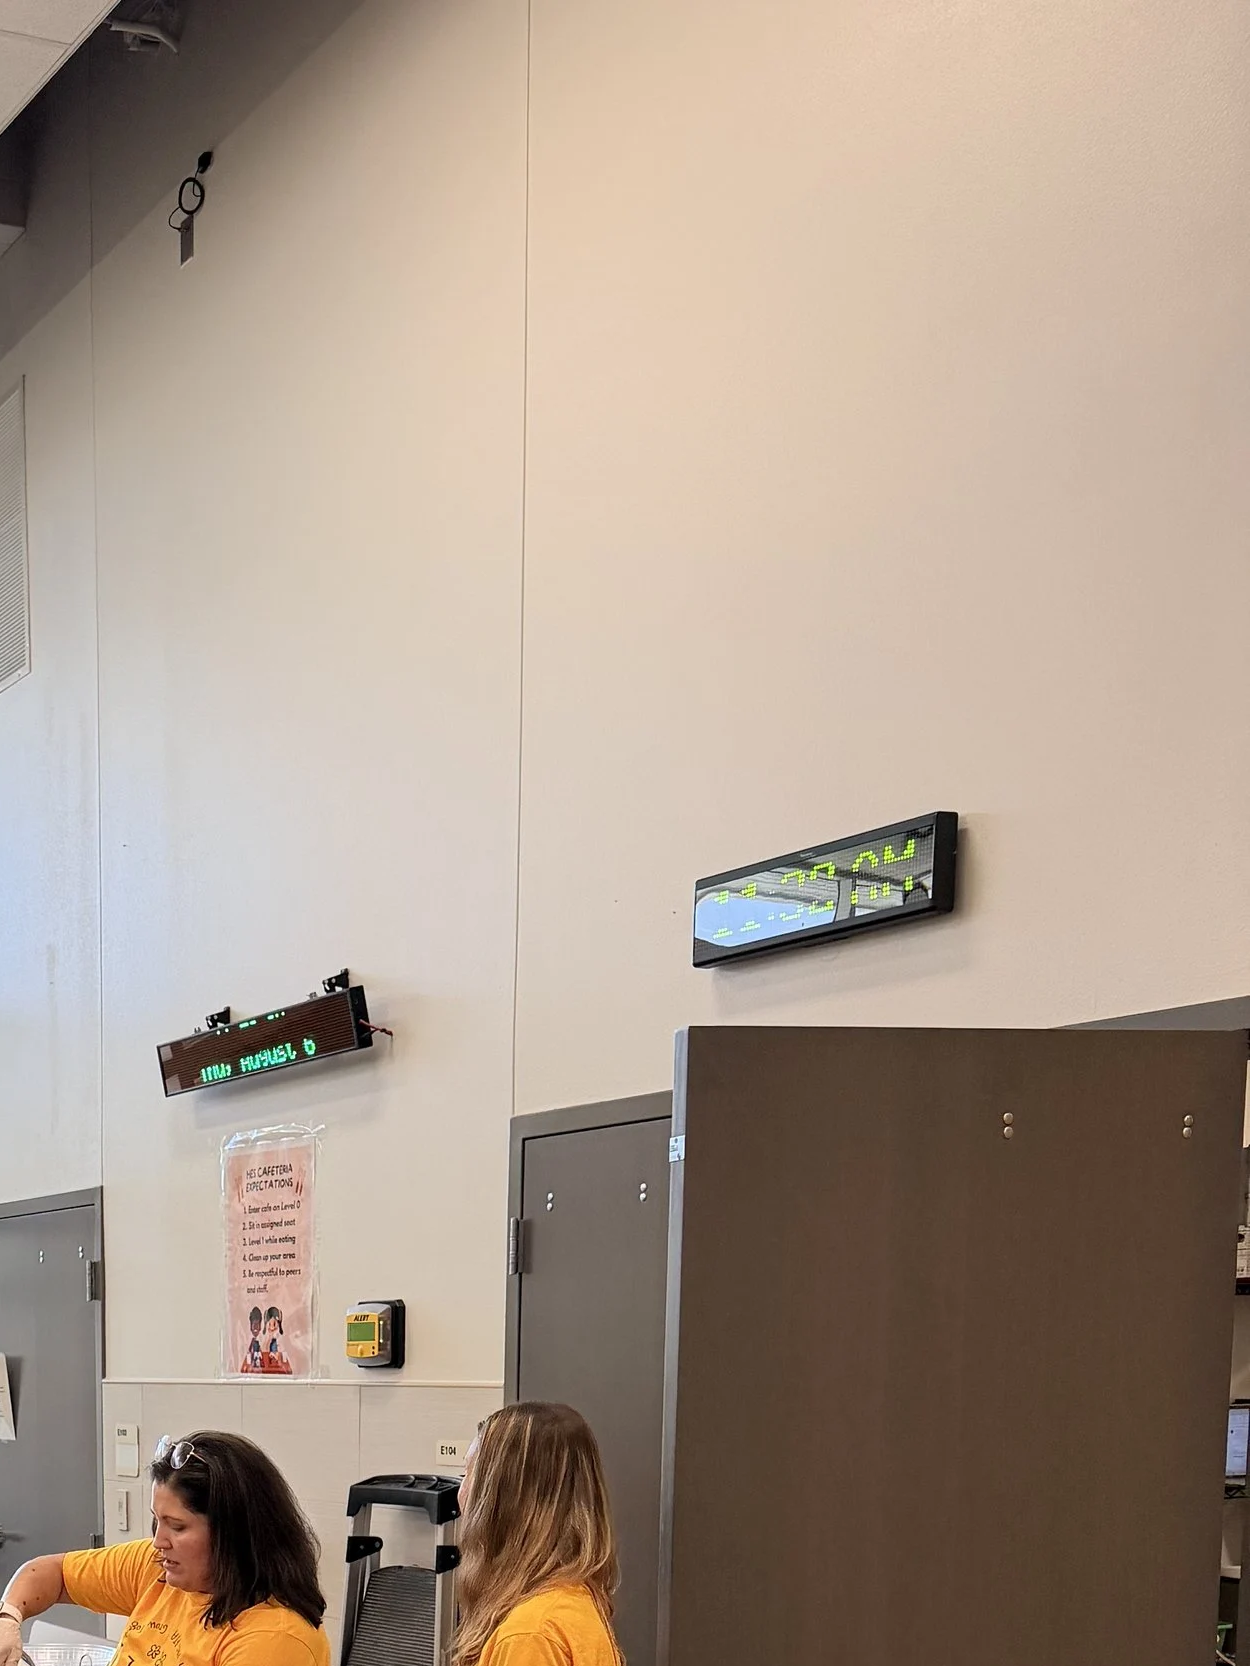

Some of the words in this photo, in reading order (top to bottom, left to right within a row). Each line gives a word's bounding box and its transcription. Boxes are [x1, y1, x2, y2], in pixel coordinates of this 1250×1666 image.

[246, 1168, 257, 1180] HES
[257, 1163, 293, 1178] CAFETERIA
[245, 1177, 294, 1193] EXPECTATIONS
[248, 1205, 261, 1214] Enter
[281, 1201, 296, 1211] Level
[255, 1220, 260, 1229] in
[261, 1218, 283, 1231] assigned
[284, 1219, 296, 1227] seat
[248, 1236, 261, 1246] Level
[265, 1235, 279, 1244] while
[278, 1235, 296, 1245] eating
[248, 1253, 262, 1262] Clean
[262, 1254, 269, 1262] up
[269, 1254, 282, 1263] your
[254, 1267, 279, 1278] respectful
[279, 1268, 285, 1276] to
[285, 1268, 301, 1277] peers
[246, 1285, 256, 1294] and
[353, 1314, 370, 1322] ALERT
[440, 1446, 457, 1456] E104
